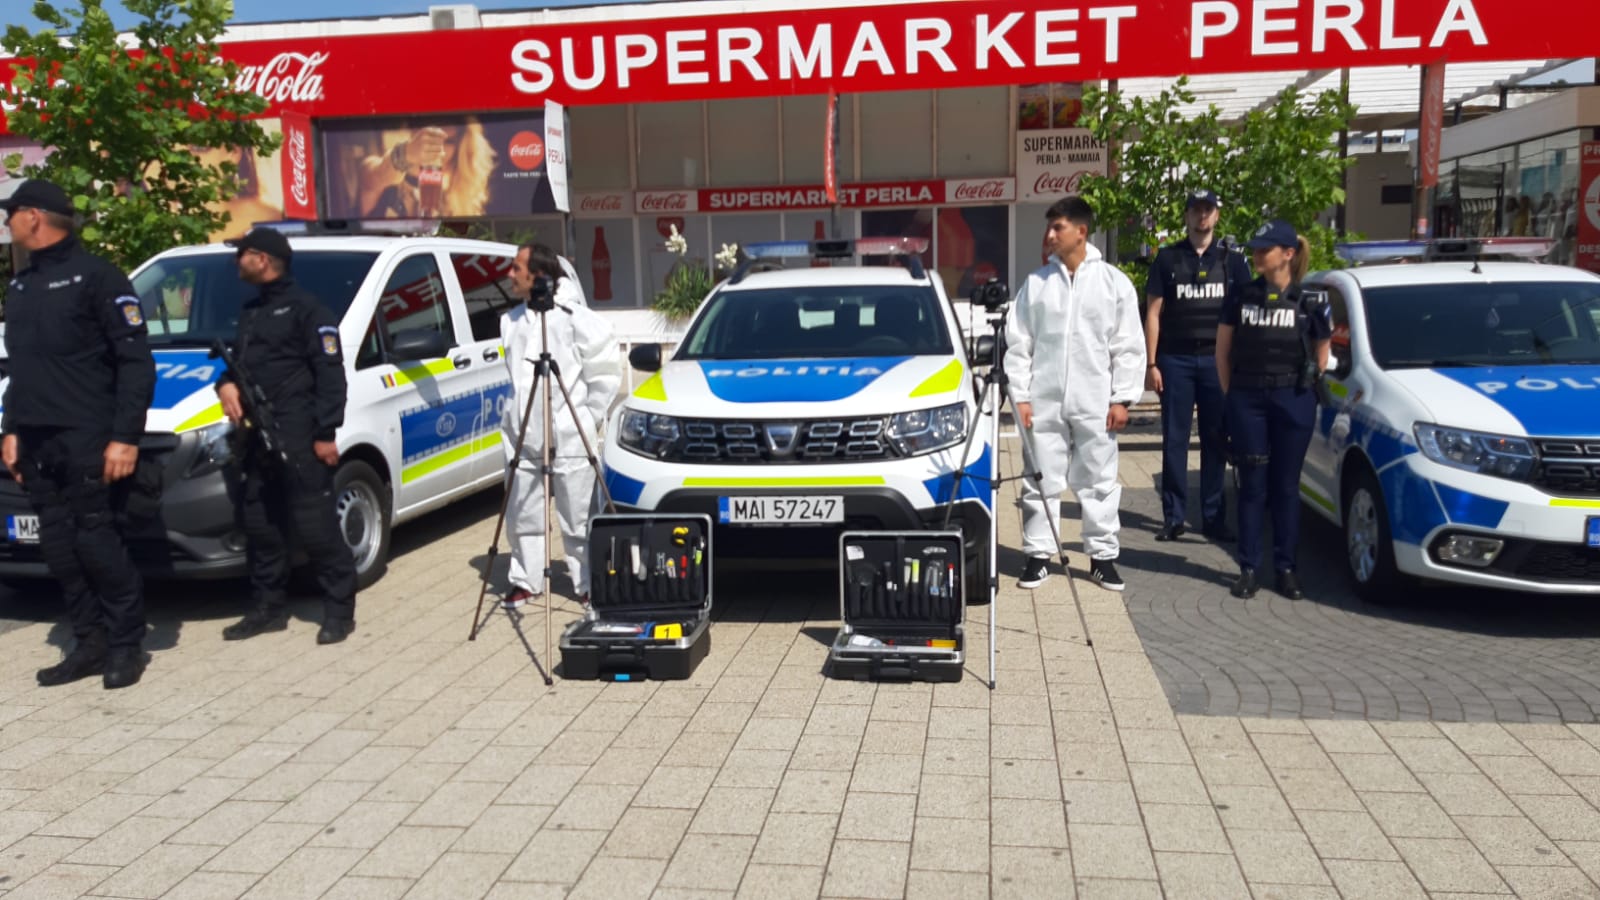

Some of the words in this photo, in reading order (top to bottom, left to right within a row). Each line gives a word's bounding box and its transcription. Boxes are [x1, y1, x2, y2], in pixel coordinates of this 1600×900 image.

[510, 5, 1137, 94] SUPERMARKET
[1189, 0, 1489, 59] PERLA
[1036, 153, 1061, 165] PERLA
[1067, 152, 1100, 162] MAMAIA
[865, 186, 933, 203] PERLA
[707, 366, 883, 379] POLITIA
[734, 500, 765, 519] MAI
[773, 500, 836, 519] 57247
